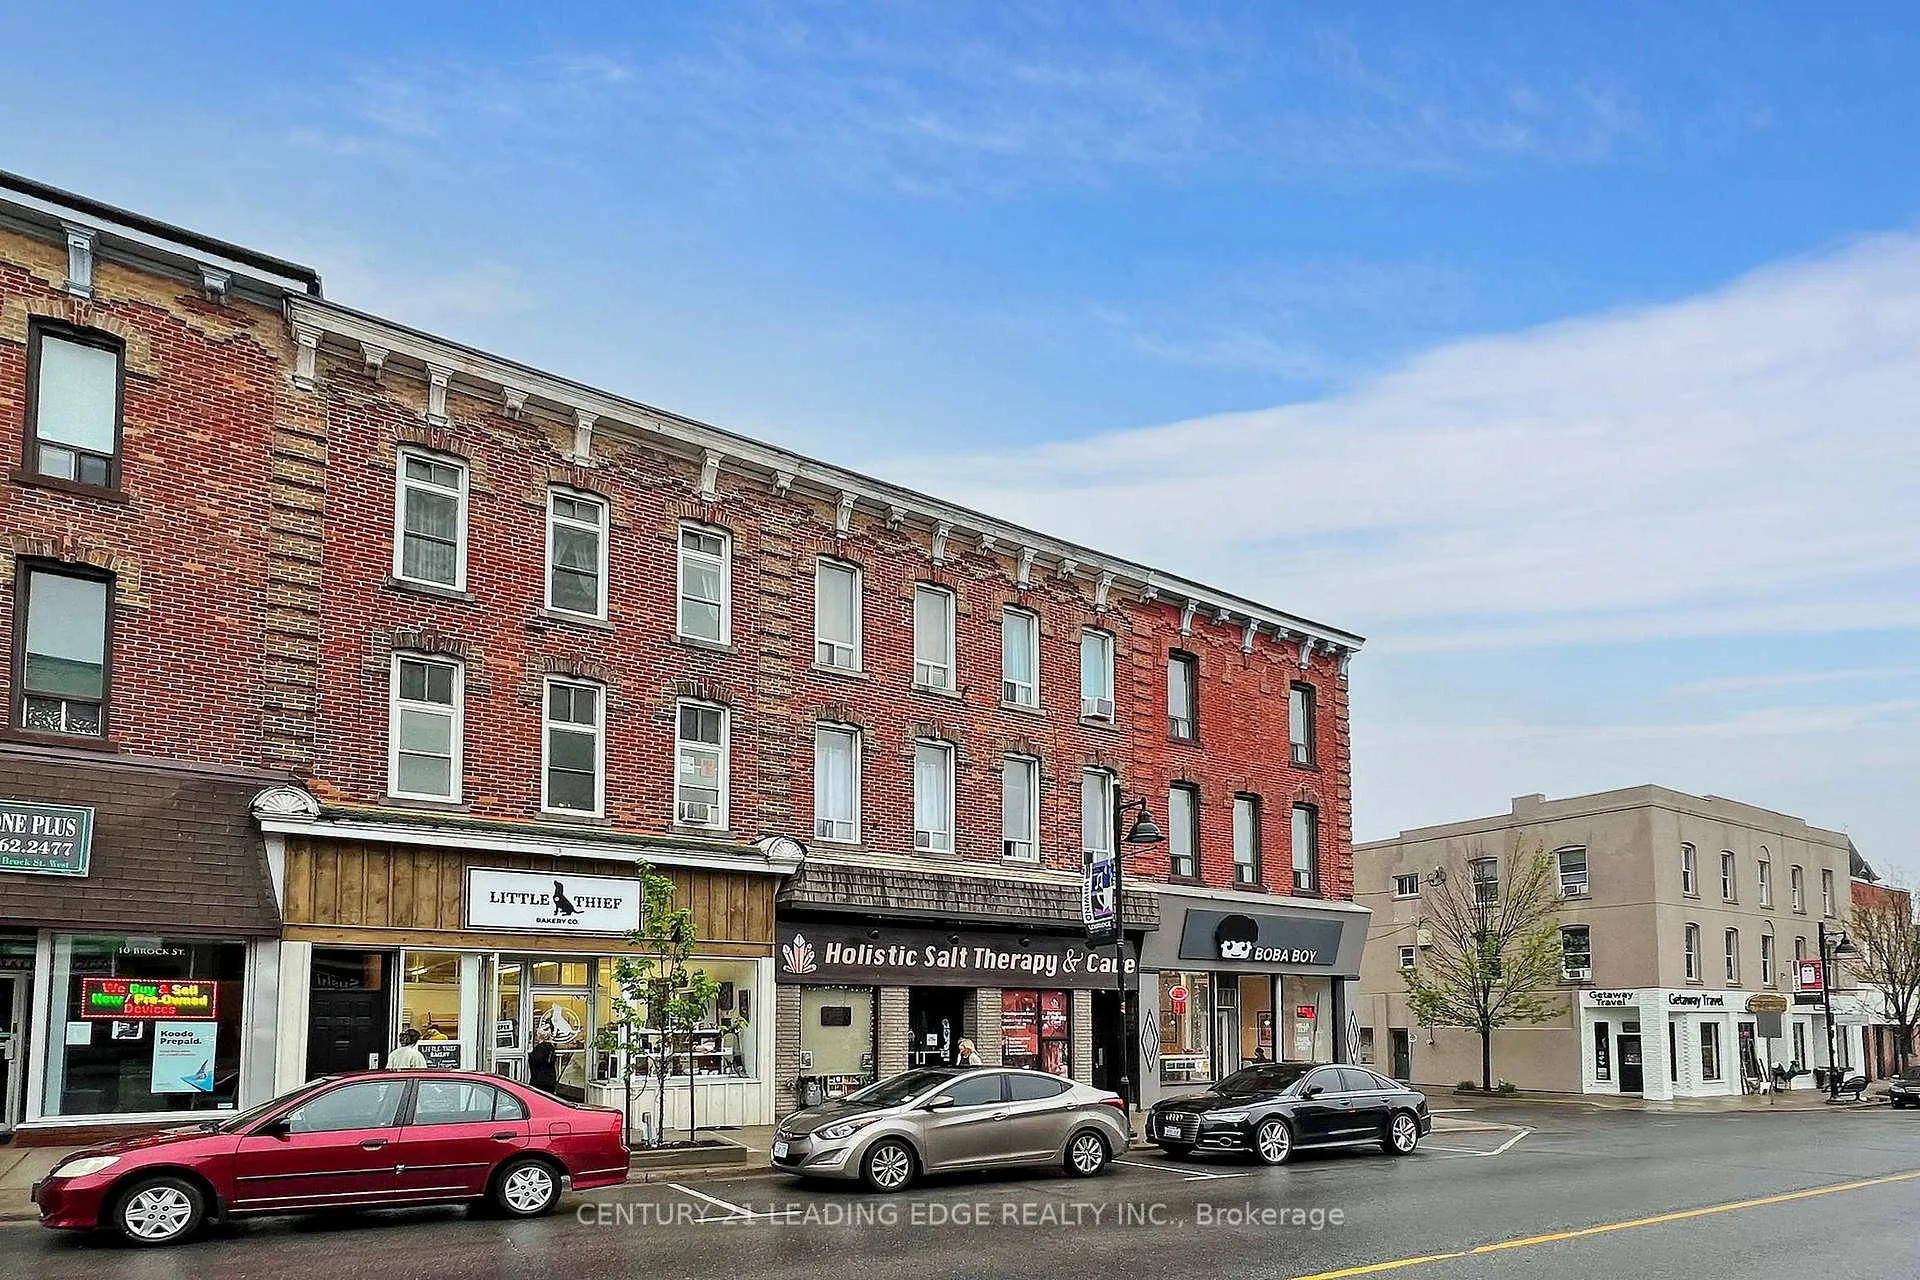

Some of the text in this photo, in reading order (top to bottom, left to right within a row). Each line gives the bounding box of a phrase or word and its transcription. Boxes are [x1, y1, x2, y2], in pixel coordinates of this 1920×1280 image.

[0, 812, 76, 836] NE PLUS
[0, 838, 74, 857] 62.2477
[2, 856, 31, 866] Brock
[489, 891, 622, 909] LITTLE THIEF
[536, 917, 566, 925] BAKERY
[133, 947, 169, 955] BROCK
[1254, 947, 1318, 963] BOBA BOY
[825, 942, 917, 966] Holistic
[924, 945, 968, 968] Salt
[974, 947, 1058, 977] Therapy
[1062, 948, 1084, 973] &
[171, 984, 199, 996] Sell
[1589, 991, 1634, 1000] Getaway
[1668, 993, 1725, 1008] Getaway Travel
[1595, 998, 1626, 1006] Travel
[124, 1004, 176, 1014] Devices
[160, 1030, 194, 1038] Koodo
[160, 1038, 202, 1046] Prepaid.
